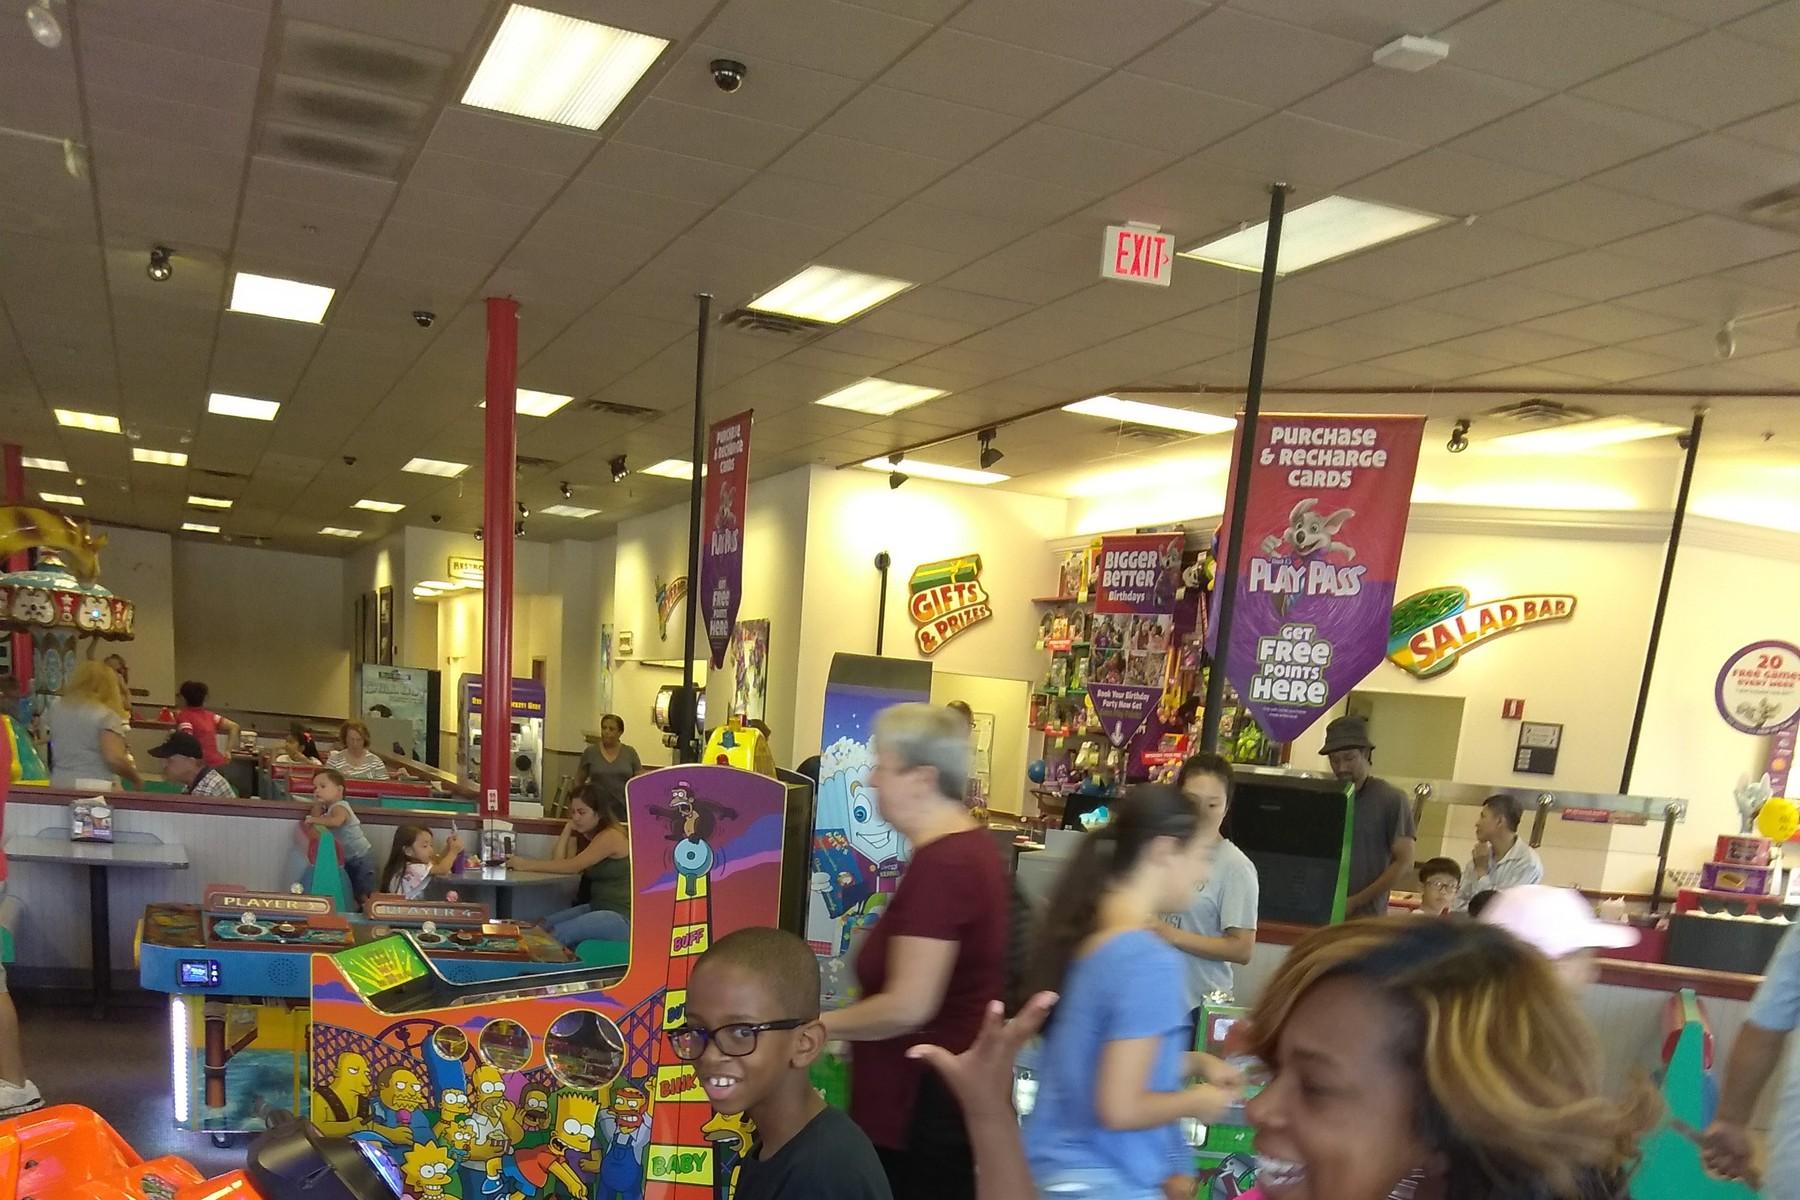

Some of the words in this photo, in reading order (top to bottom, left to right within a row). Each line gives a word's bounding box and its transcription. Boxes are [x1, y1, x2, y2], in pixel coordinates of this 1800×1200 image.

[1116, 231, 1166, 278] EXIT
[1260, 448, 1273, 465] &
[1249, 558, 1306, 593] PLAY
[1307, 560, 1367, 597] PASS
[912, 583, 978, 623] GIFTS
[1108, 590, 1146, 603] Birthdays
[921, 631, 937, 651] &
[934, 606, 986, 640] PRIZES
[1410, 604, 1517, 669] SALAD
[1524, 600, 1566, 621] BAR
[1758, 655, 1783, 669] 20
[224, 897, 298, 909] PLAYER
[384, 905, 455, 916] PLAYER
[673, 927, 705, 952] BUFF
[651, 1152, 707, 1177] BABY
